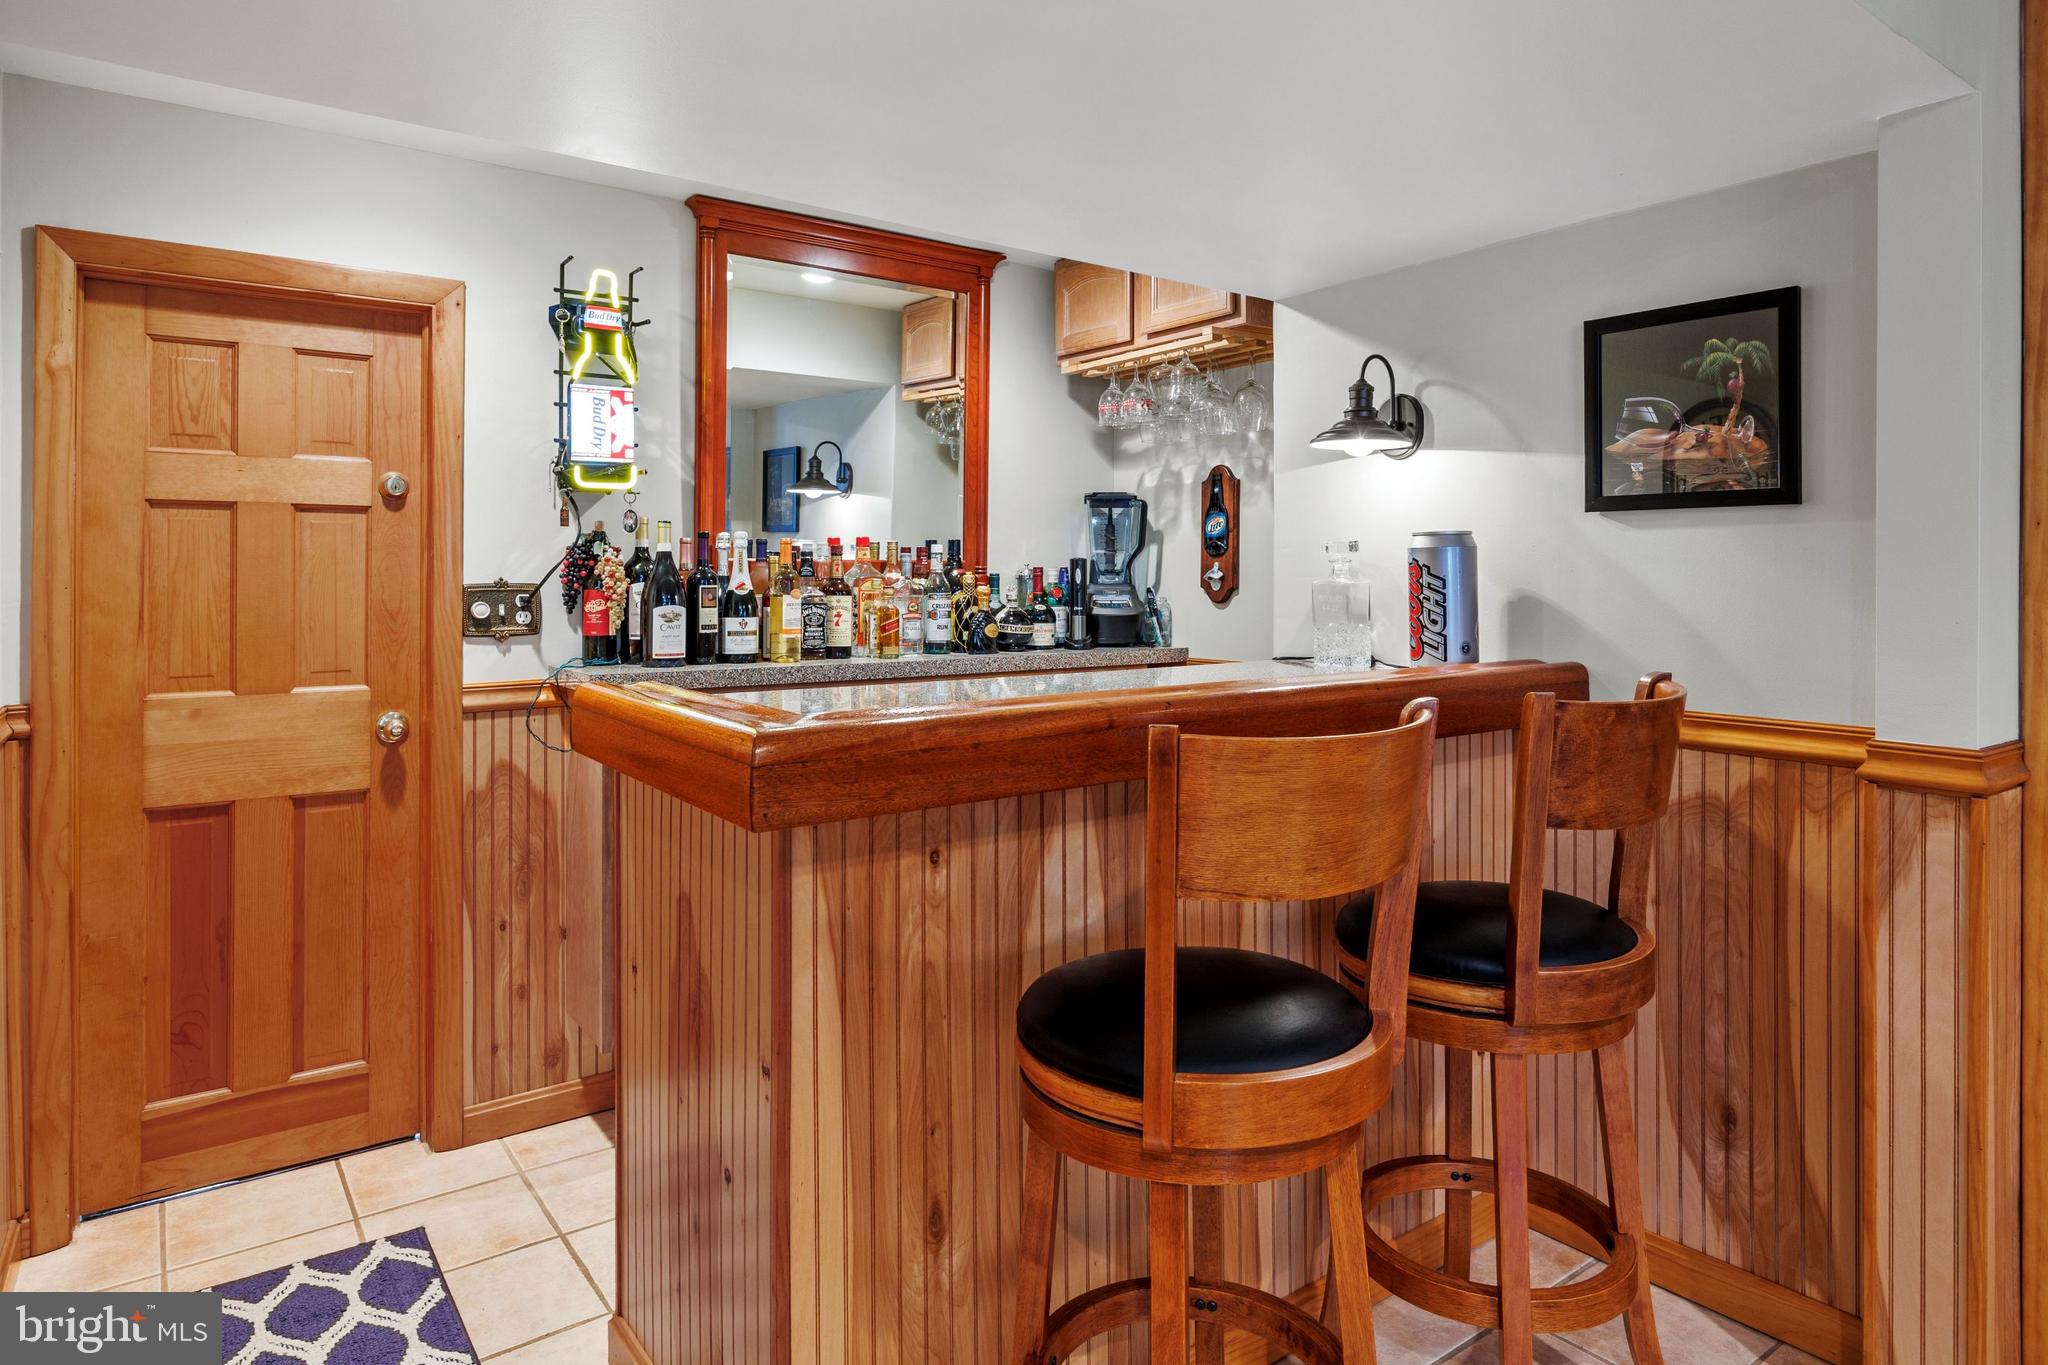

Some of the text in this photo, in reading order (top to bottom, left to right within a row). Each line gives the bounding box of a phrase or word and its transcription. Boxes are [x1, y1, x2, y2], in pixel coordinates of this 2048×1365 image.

[588, 310, 621, 323] Bud Dry
[591, 397, 606, 451] Bud Dry
[832, 611, 843, 627] 7
[1408, 557, 1424, 661] Coors
[1422, 563, 1447, 662] LIGHT
[659, 623, 681, 632] CAVIT
